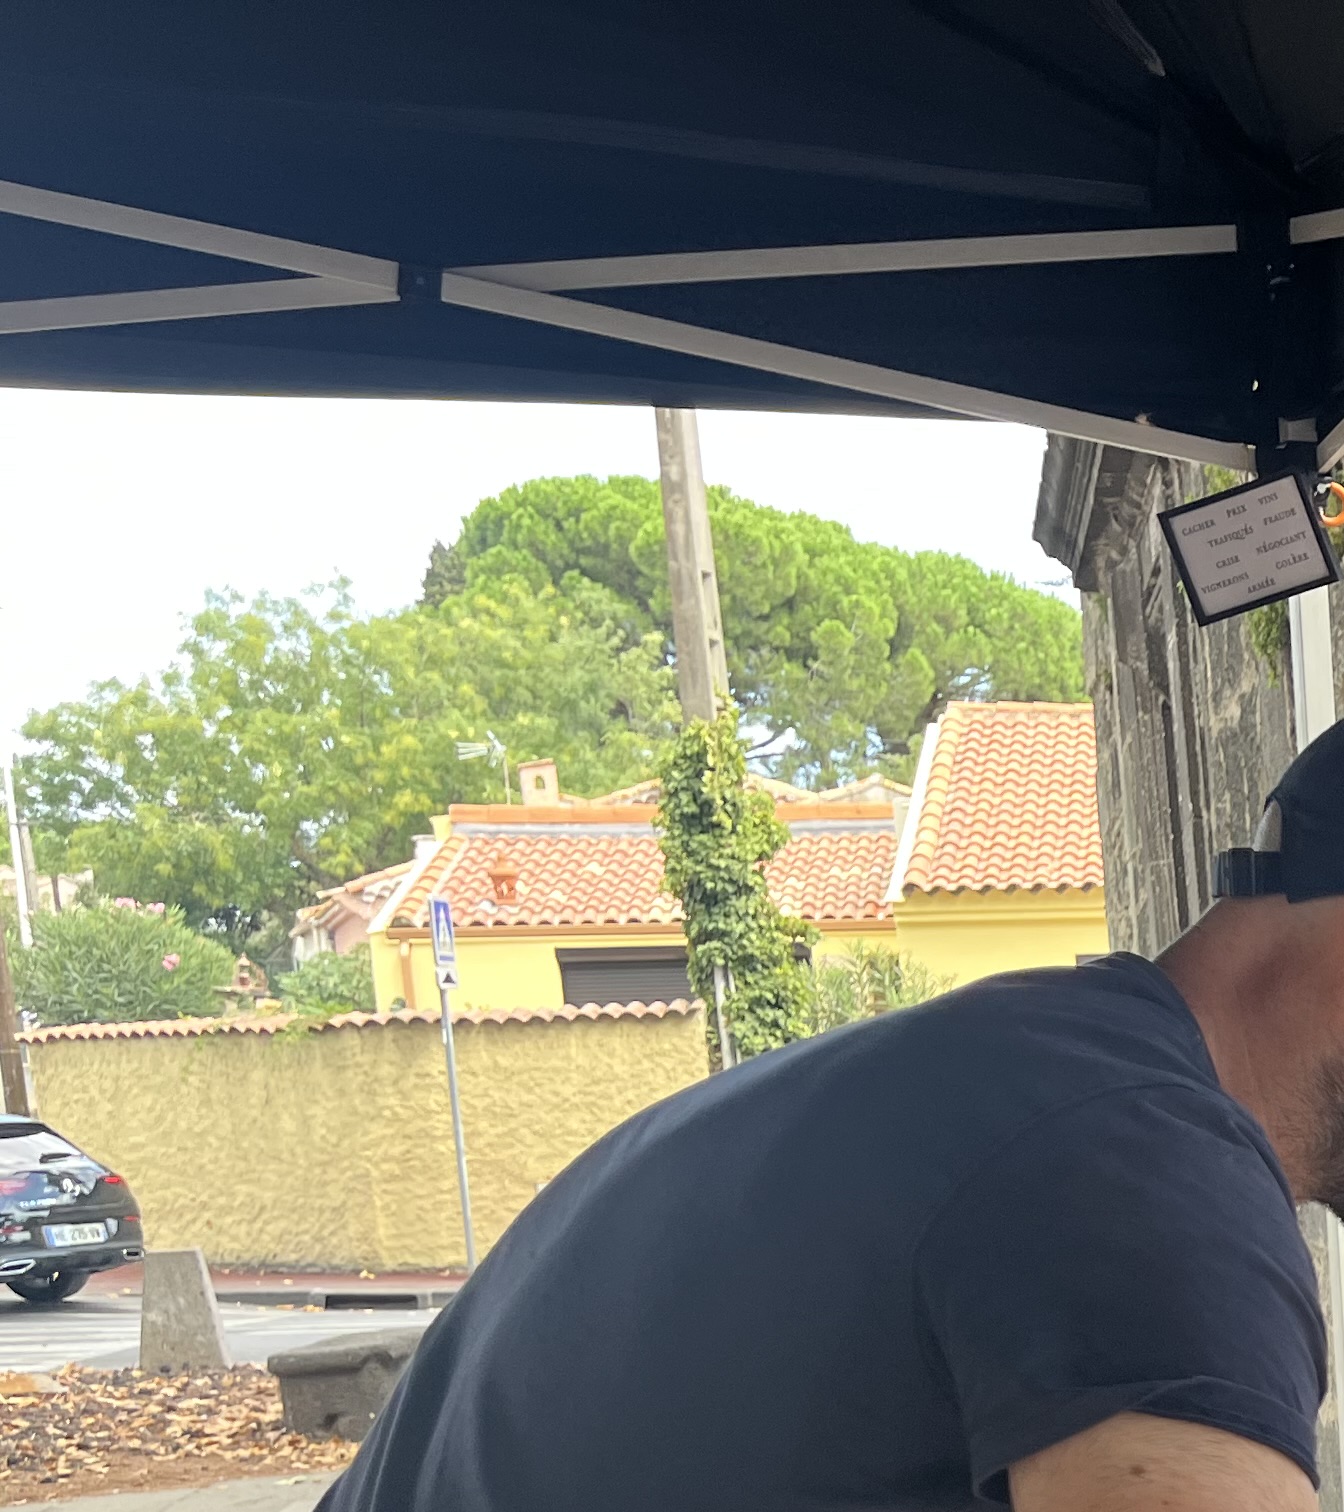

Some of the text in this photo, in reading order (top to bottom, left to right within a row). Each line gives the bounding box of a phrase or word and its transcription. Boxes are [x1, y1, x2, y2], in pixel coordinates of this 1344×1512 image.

[1257, 492, 1279, 506] VINS
[1226, 504, 1248, 519] PRIX
[1263, 508, 1297, 526] FRAUDE
[1182, 519, 1216, 537] CACHER
[1216, 555, 1241, 569] CRISE
[1201, 572, 1250, 595] VIGNERONS
